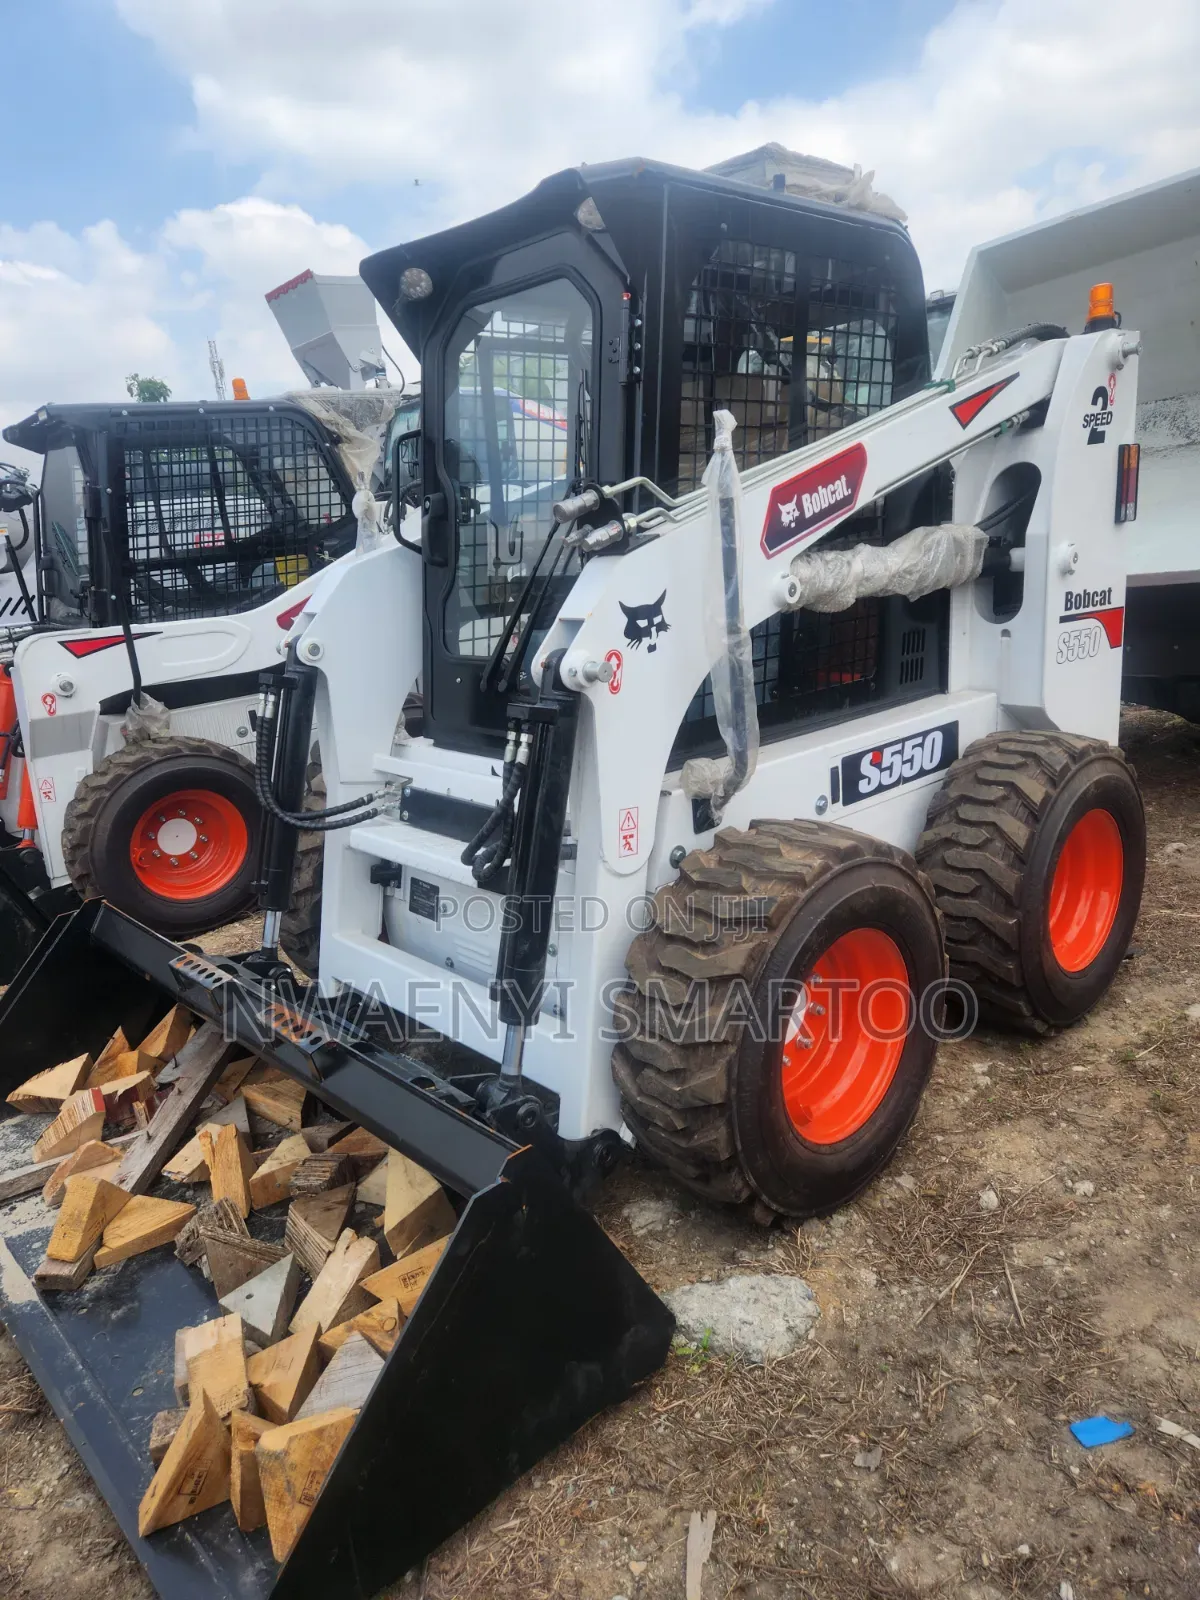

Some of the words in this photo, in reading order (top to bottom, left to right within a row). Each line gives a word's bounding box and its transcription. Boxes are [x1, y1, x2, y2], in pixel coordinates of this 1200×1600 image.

[1082, 411, 1113, 428] SPEED
[1087, 386, 1109, 445] 2
[1064, 587, 1112, 612] Bobcat
[1056, 626, 1101, 664] S550
[858, 730, 944, 794] S550
